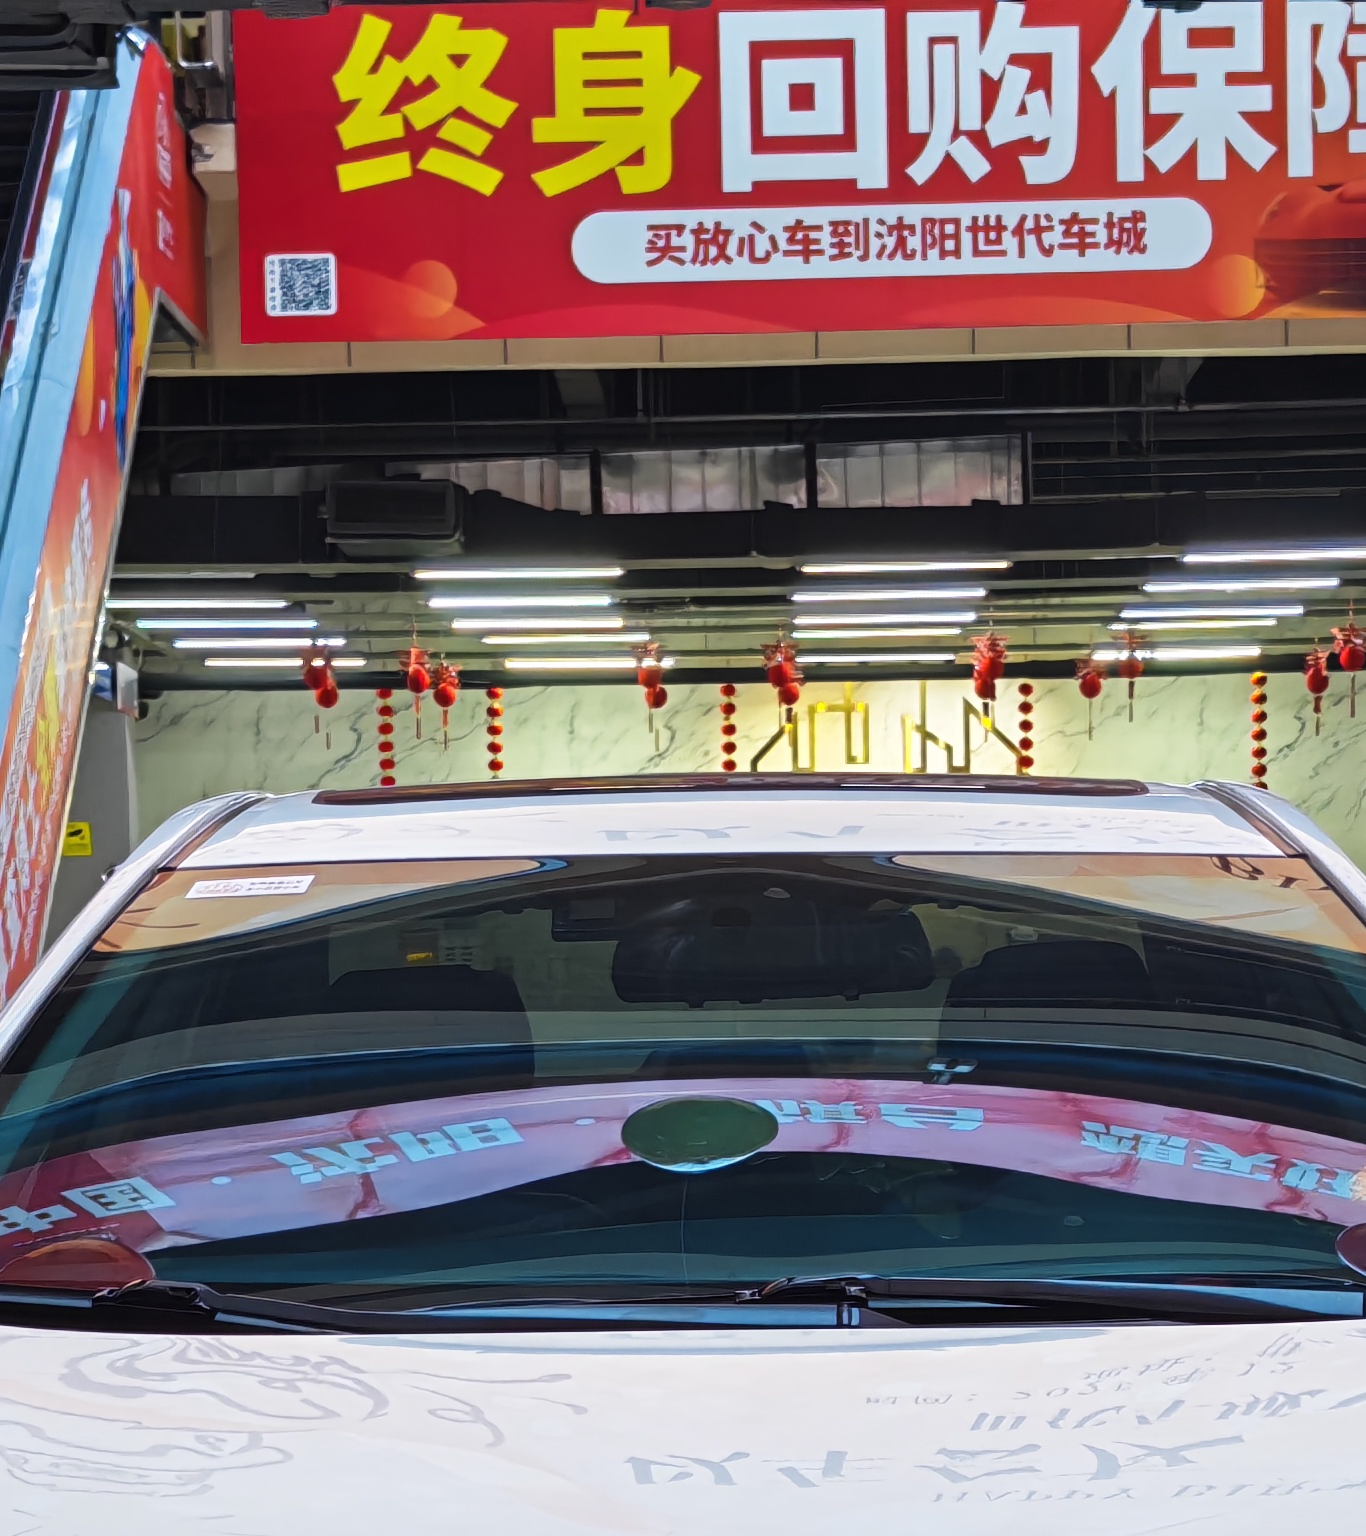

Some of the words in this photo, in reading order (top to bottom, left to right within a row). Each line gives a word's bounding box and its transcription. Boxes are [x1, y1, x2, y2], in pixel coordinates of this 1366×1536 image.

[644, 210, 1148, 267] 买放心车到沈阳世代车城
